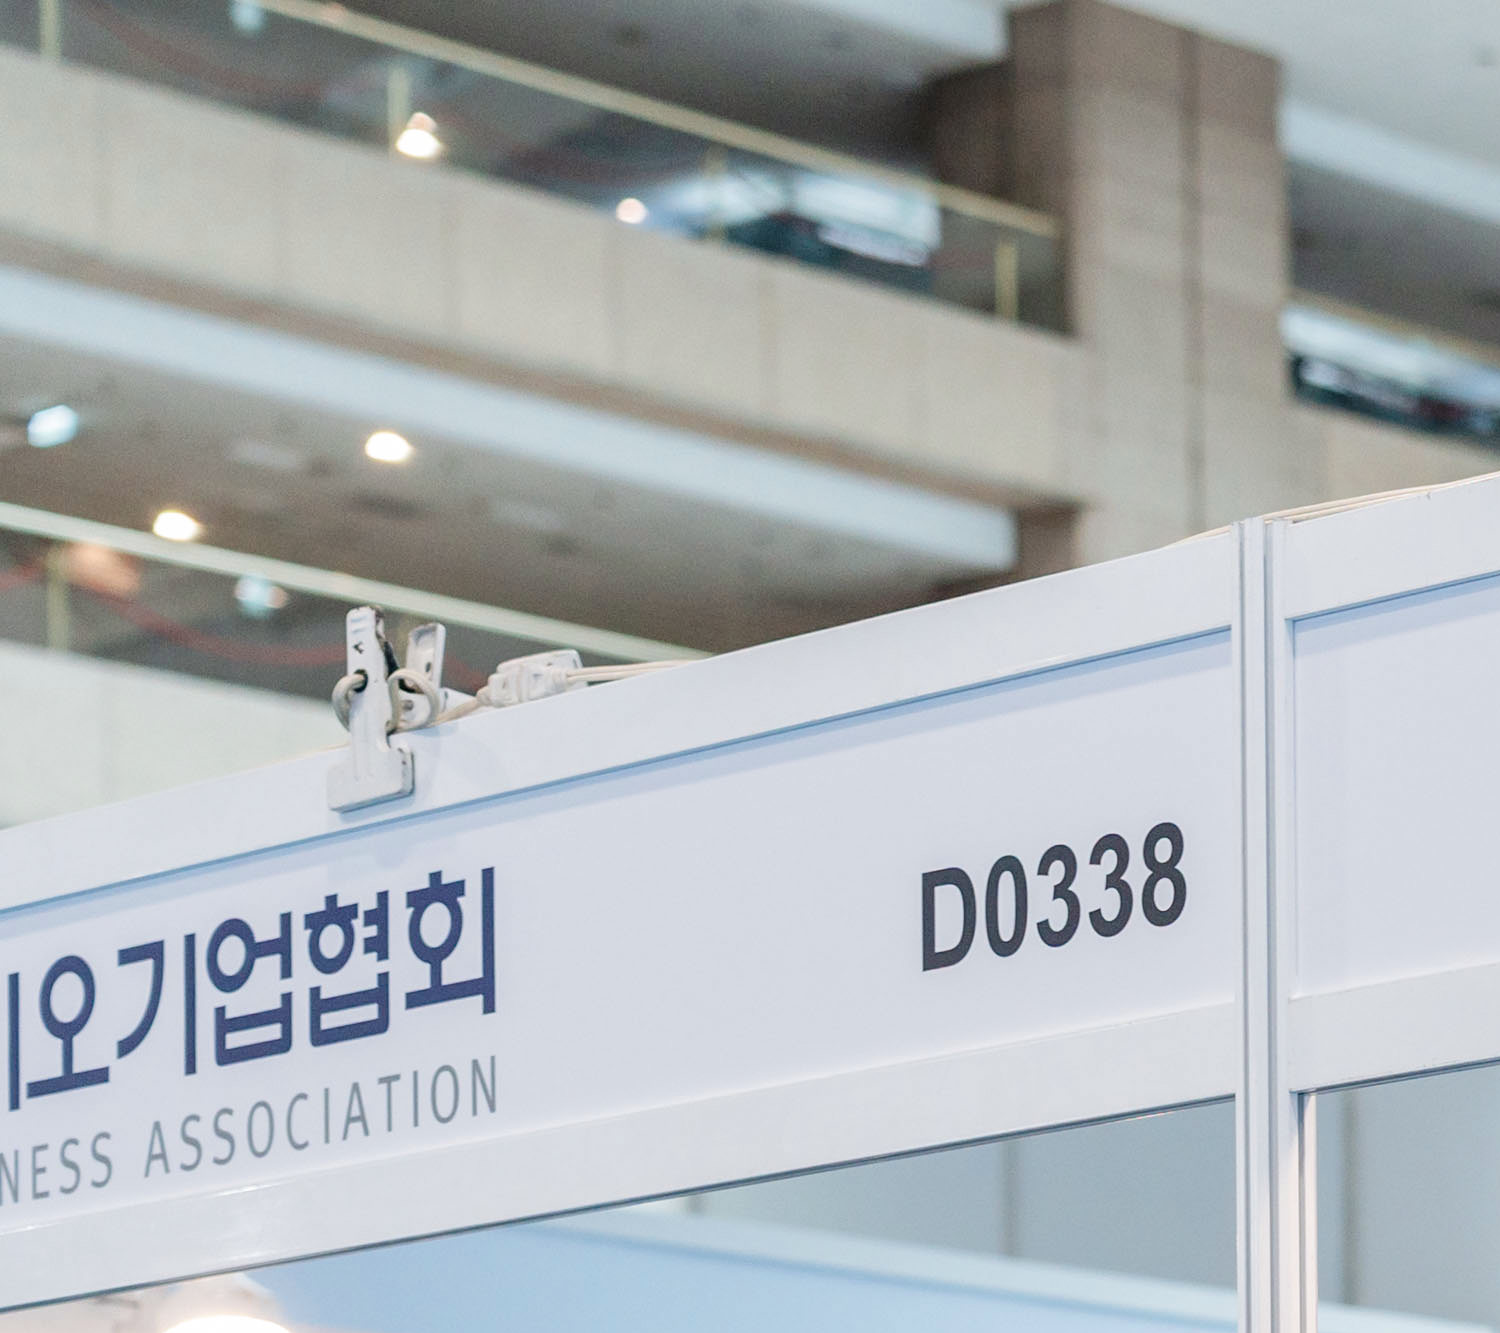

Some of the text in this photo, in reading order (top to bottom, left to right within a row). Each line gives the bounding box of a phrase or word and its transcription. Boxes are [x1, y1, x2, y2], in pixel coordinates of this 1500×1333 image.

[921, 821, 1187, 972] D0338
[6, 866, 497, 1112] 오기업협회
[145, 1055, 496, 1177] ASSOCIATION
